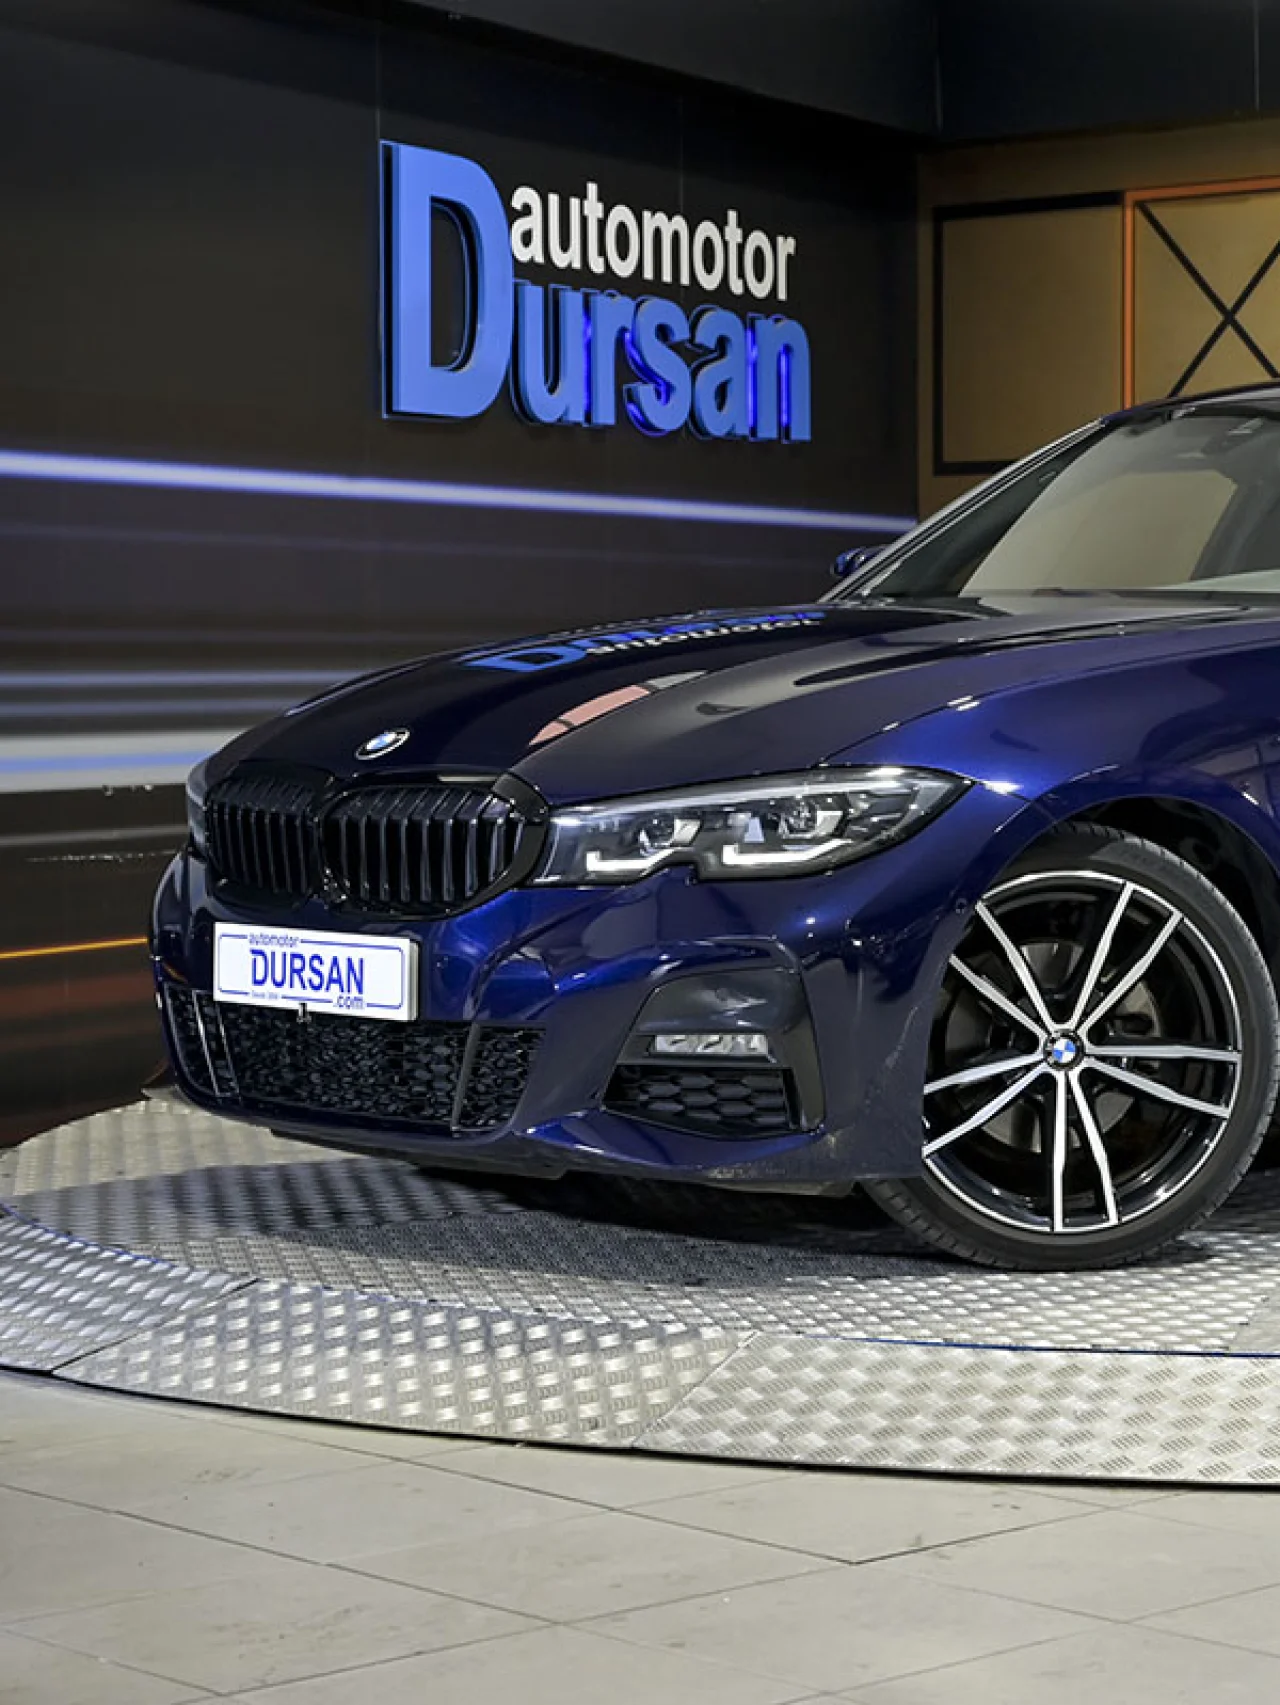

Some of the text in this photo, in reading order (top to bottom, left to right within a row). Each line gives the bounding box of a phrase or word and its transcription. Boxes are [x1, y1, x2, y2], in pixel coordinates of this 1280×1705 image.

[380, 139, 812, 444] Dursan
[510, 181, 796, 301] automotor
[250, 949, 365, 995] DURSAN
